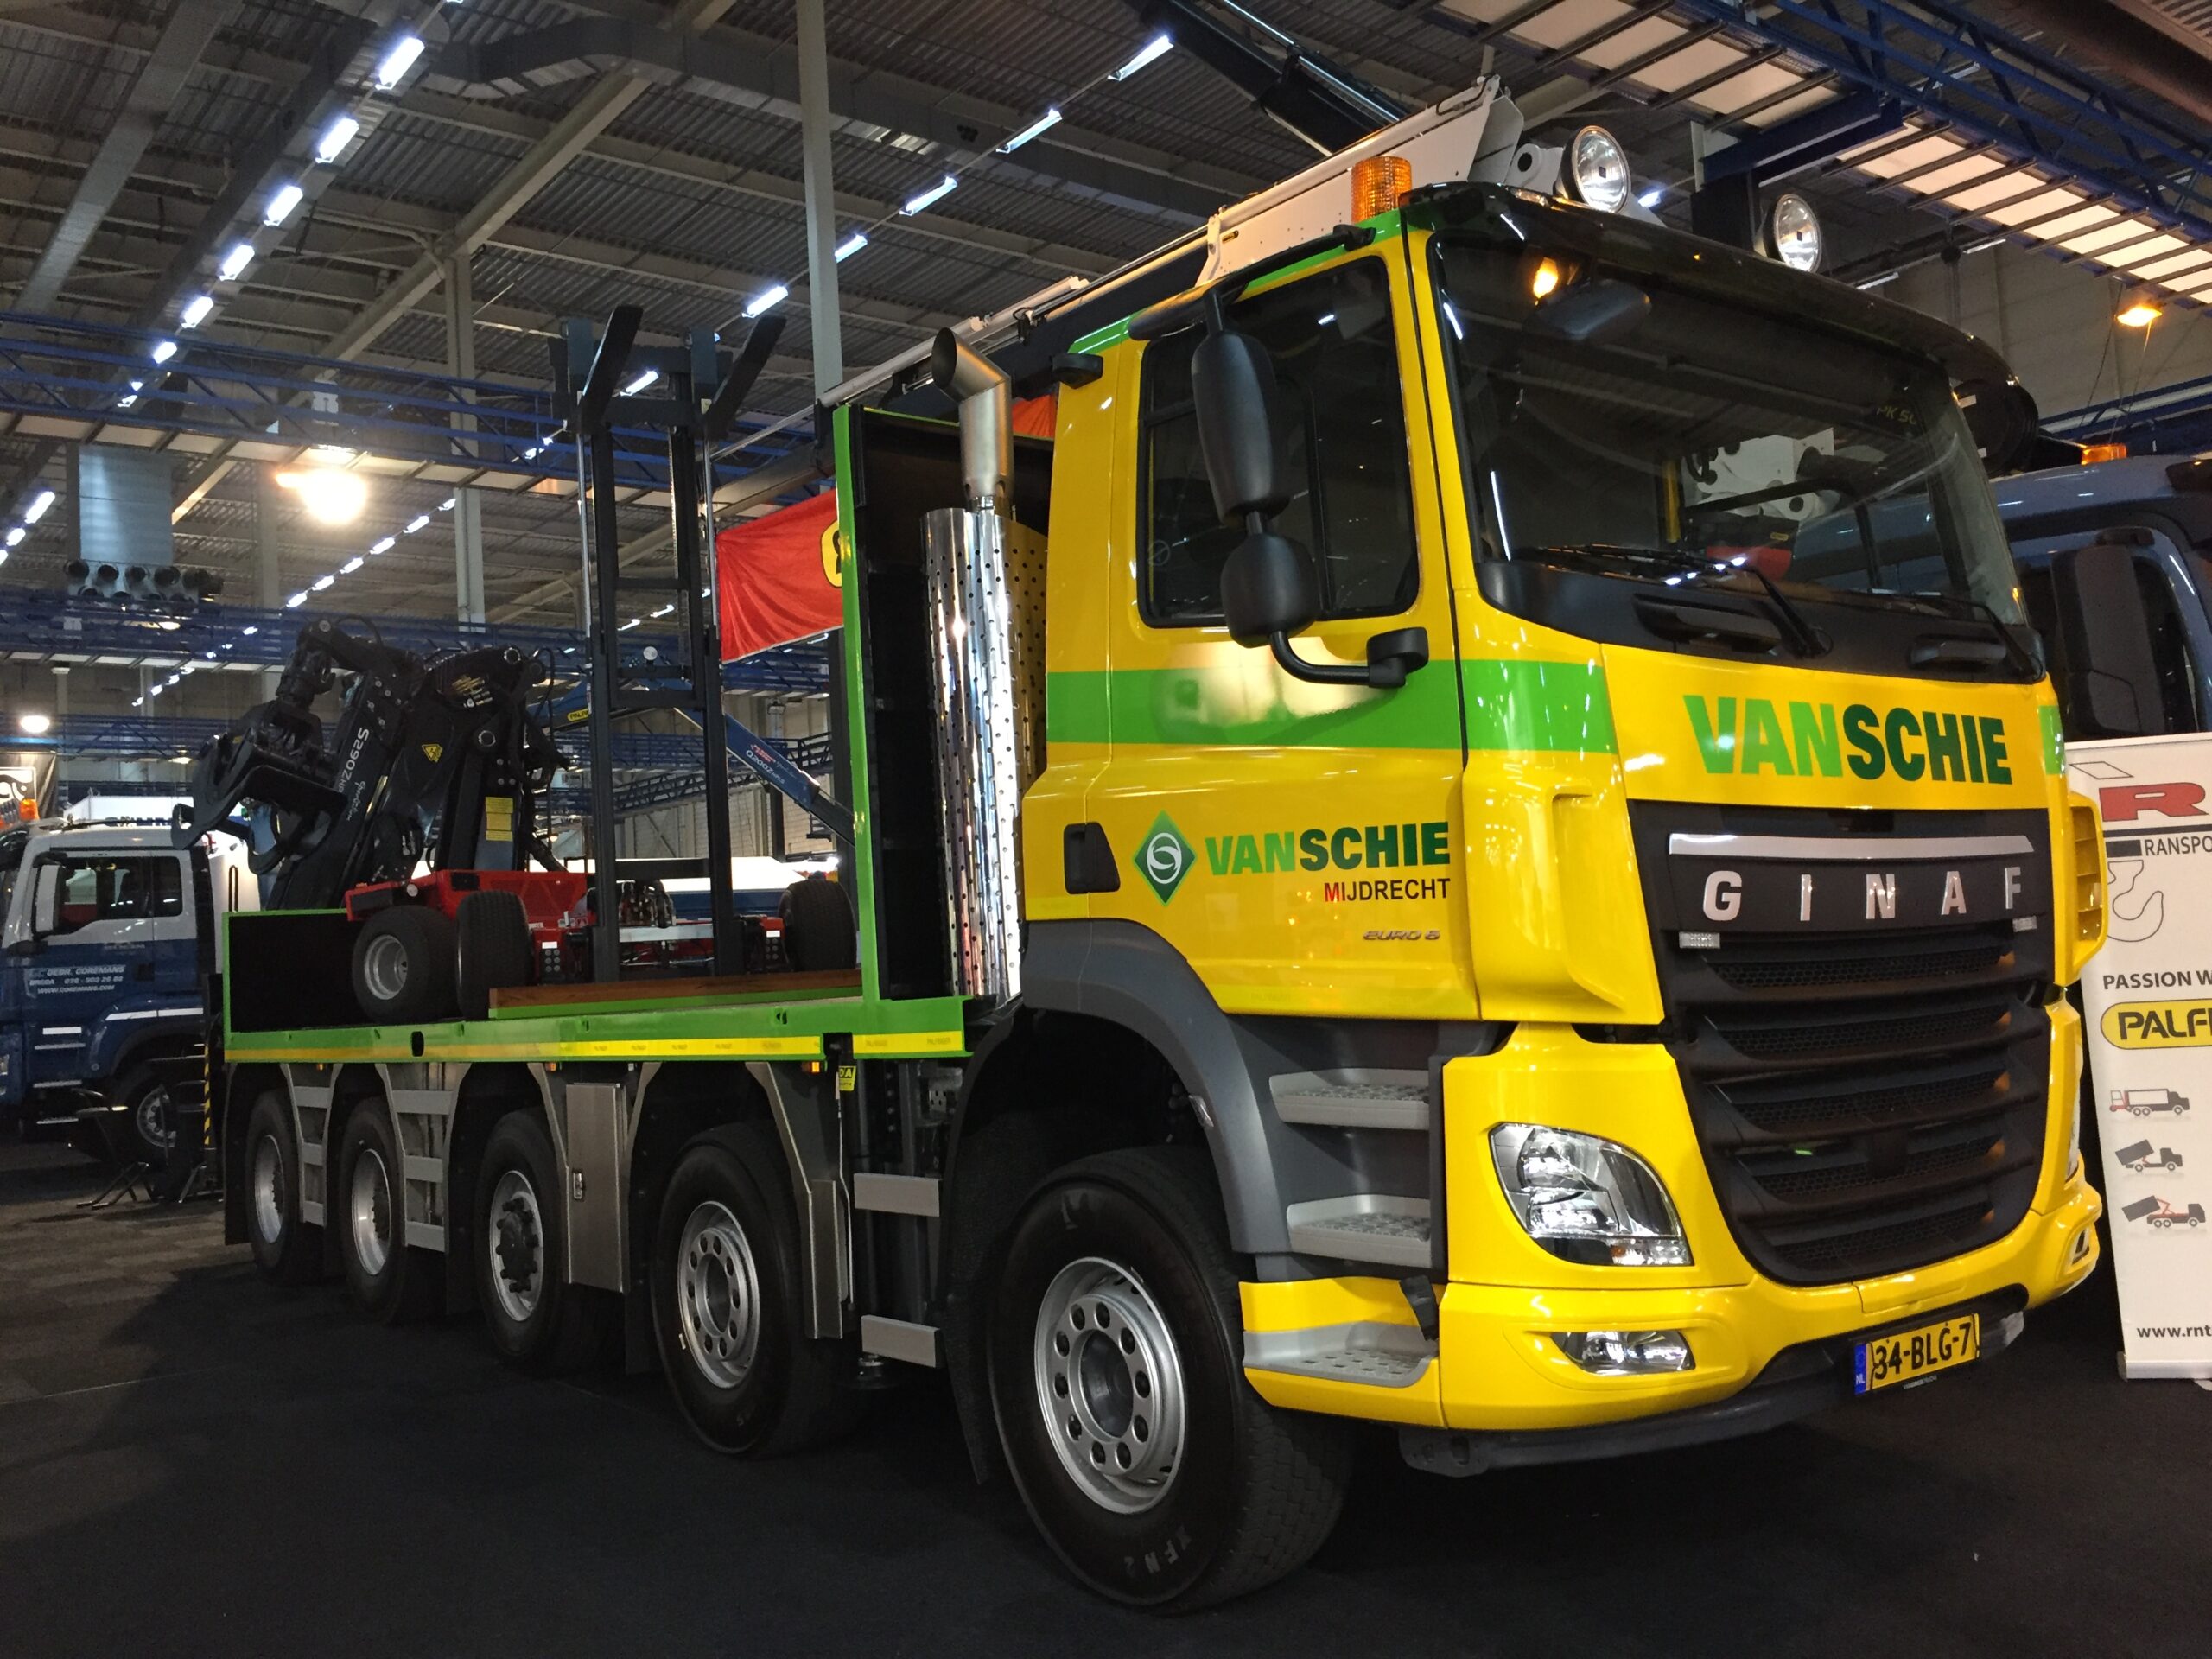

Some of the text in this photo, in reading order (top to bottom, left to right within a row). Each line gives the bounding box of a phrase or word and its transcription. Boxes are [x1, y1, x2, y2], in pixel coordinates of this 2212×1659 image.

[1682, 695, 2012, 785] VANSCHIE
[1205, 822, 1450, 875] VANSCHIE
[1324, 878, 1451, 902] MIJDRECHT
[1702, 866, 2022, 922] GINAF
[1363, 929, 1440, 941] EURO 6
[2102, 971, 2192, 990] PASSION
[2137, 1325, 2212, 1338] www.rnt
[1874, 1322, 1972, 1380] 34-BLG-7
[1855, 1375, 1866, 1384] NL
